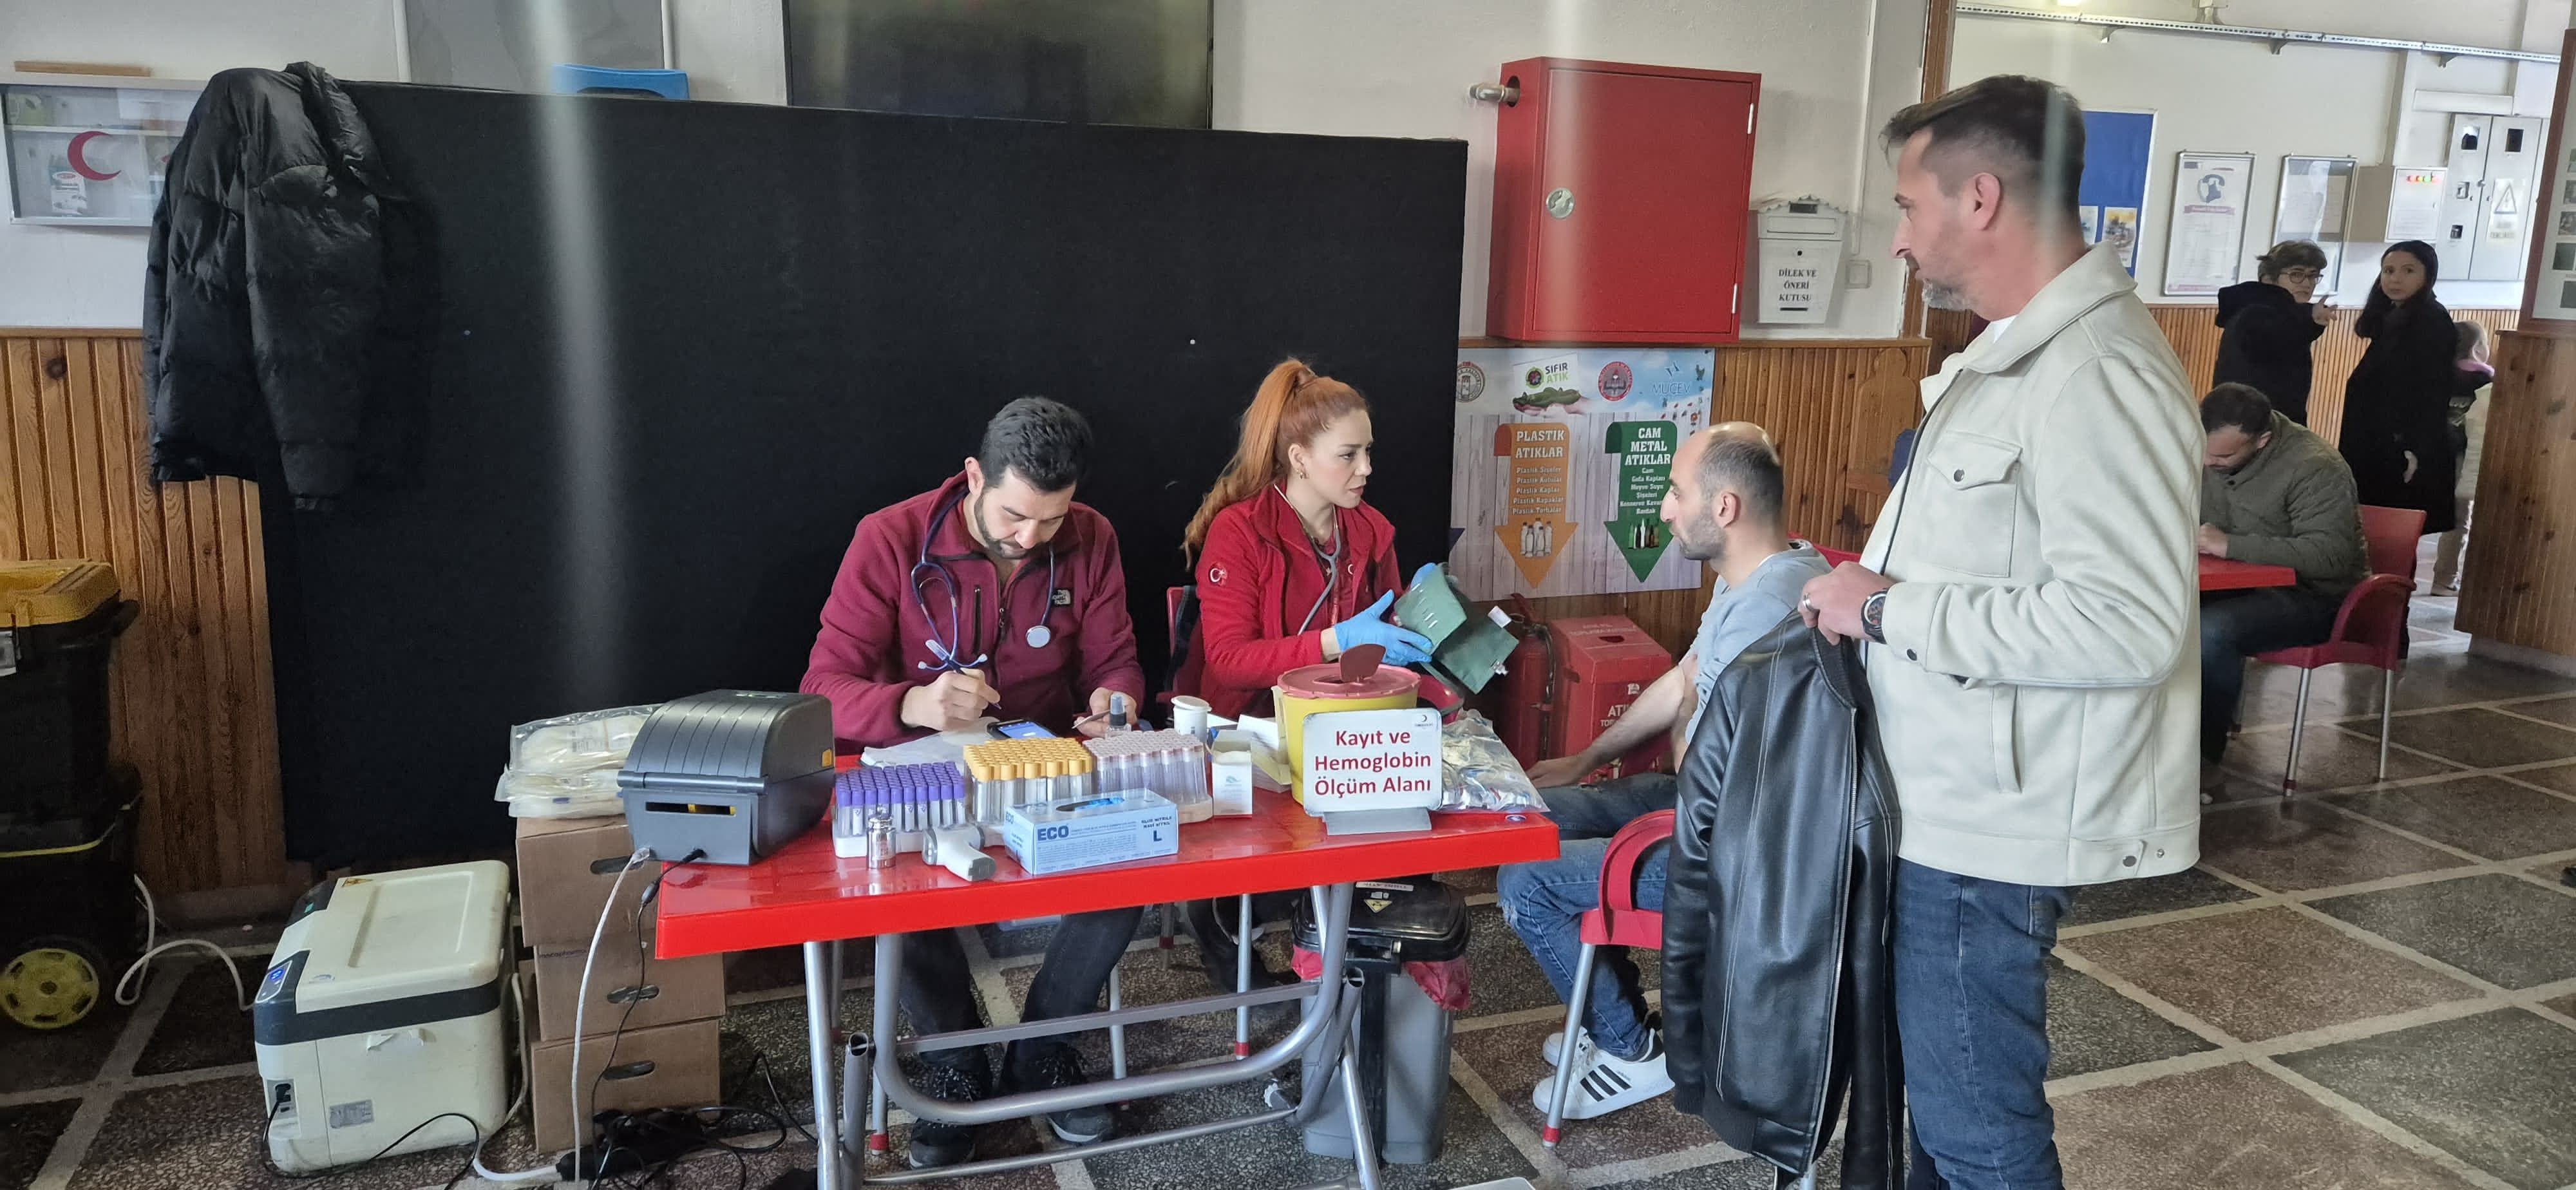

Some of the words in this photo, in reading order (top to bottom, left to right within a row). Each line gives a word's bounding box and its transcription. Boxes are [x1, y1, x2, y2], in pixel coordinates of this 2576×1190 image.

[1778, 268, 1803, 278] DİLEK
[1806, 269, 1817, 278] VE
[1783, 280, 1809, 289] ÖNERİ
[1545, 363, 1568, 374] SIFIR
[1547, 372, 1568, 383] ATIK
[1517, 428, 1564, 442] PLASTİK
[1638, 428, 1661, 439] CAM
[1631, 440, 1667, 452] METAL
[1515, 447, 1564, 458] ATIKLAR
[1625, 454, 1671, 465] ATIKLAR
[1336, 730, 1383, 749] Kayıt
[1388, 731, 1411, 744] ve
[1315, 751, 1431, 773] Hemoglobin
[1314, 775, 1376, 799] Ölçüm
[1383, 776, 1431, 793] Alanı
[1005, 811, 1014, 825] ECO
[1037, 825, 1069, 842] ECO
[1153, 830, 1162, 842] L
